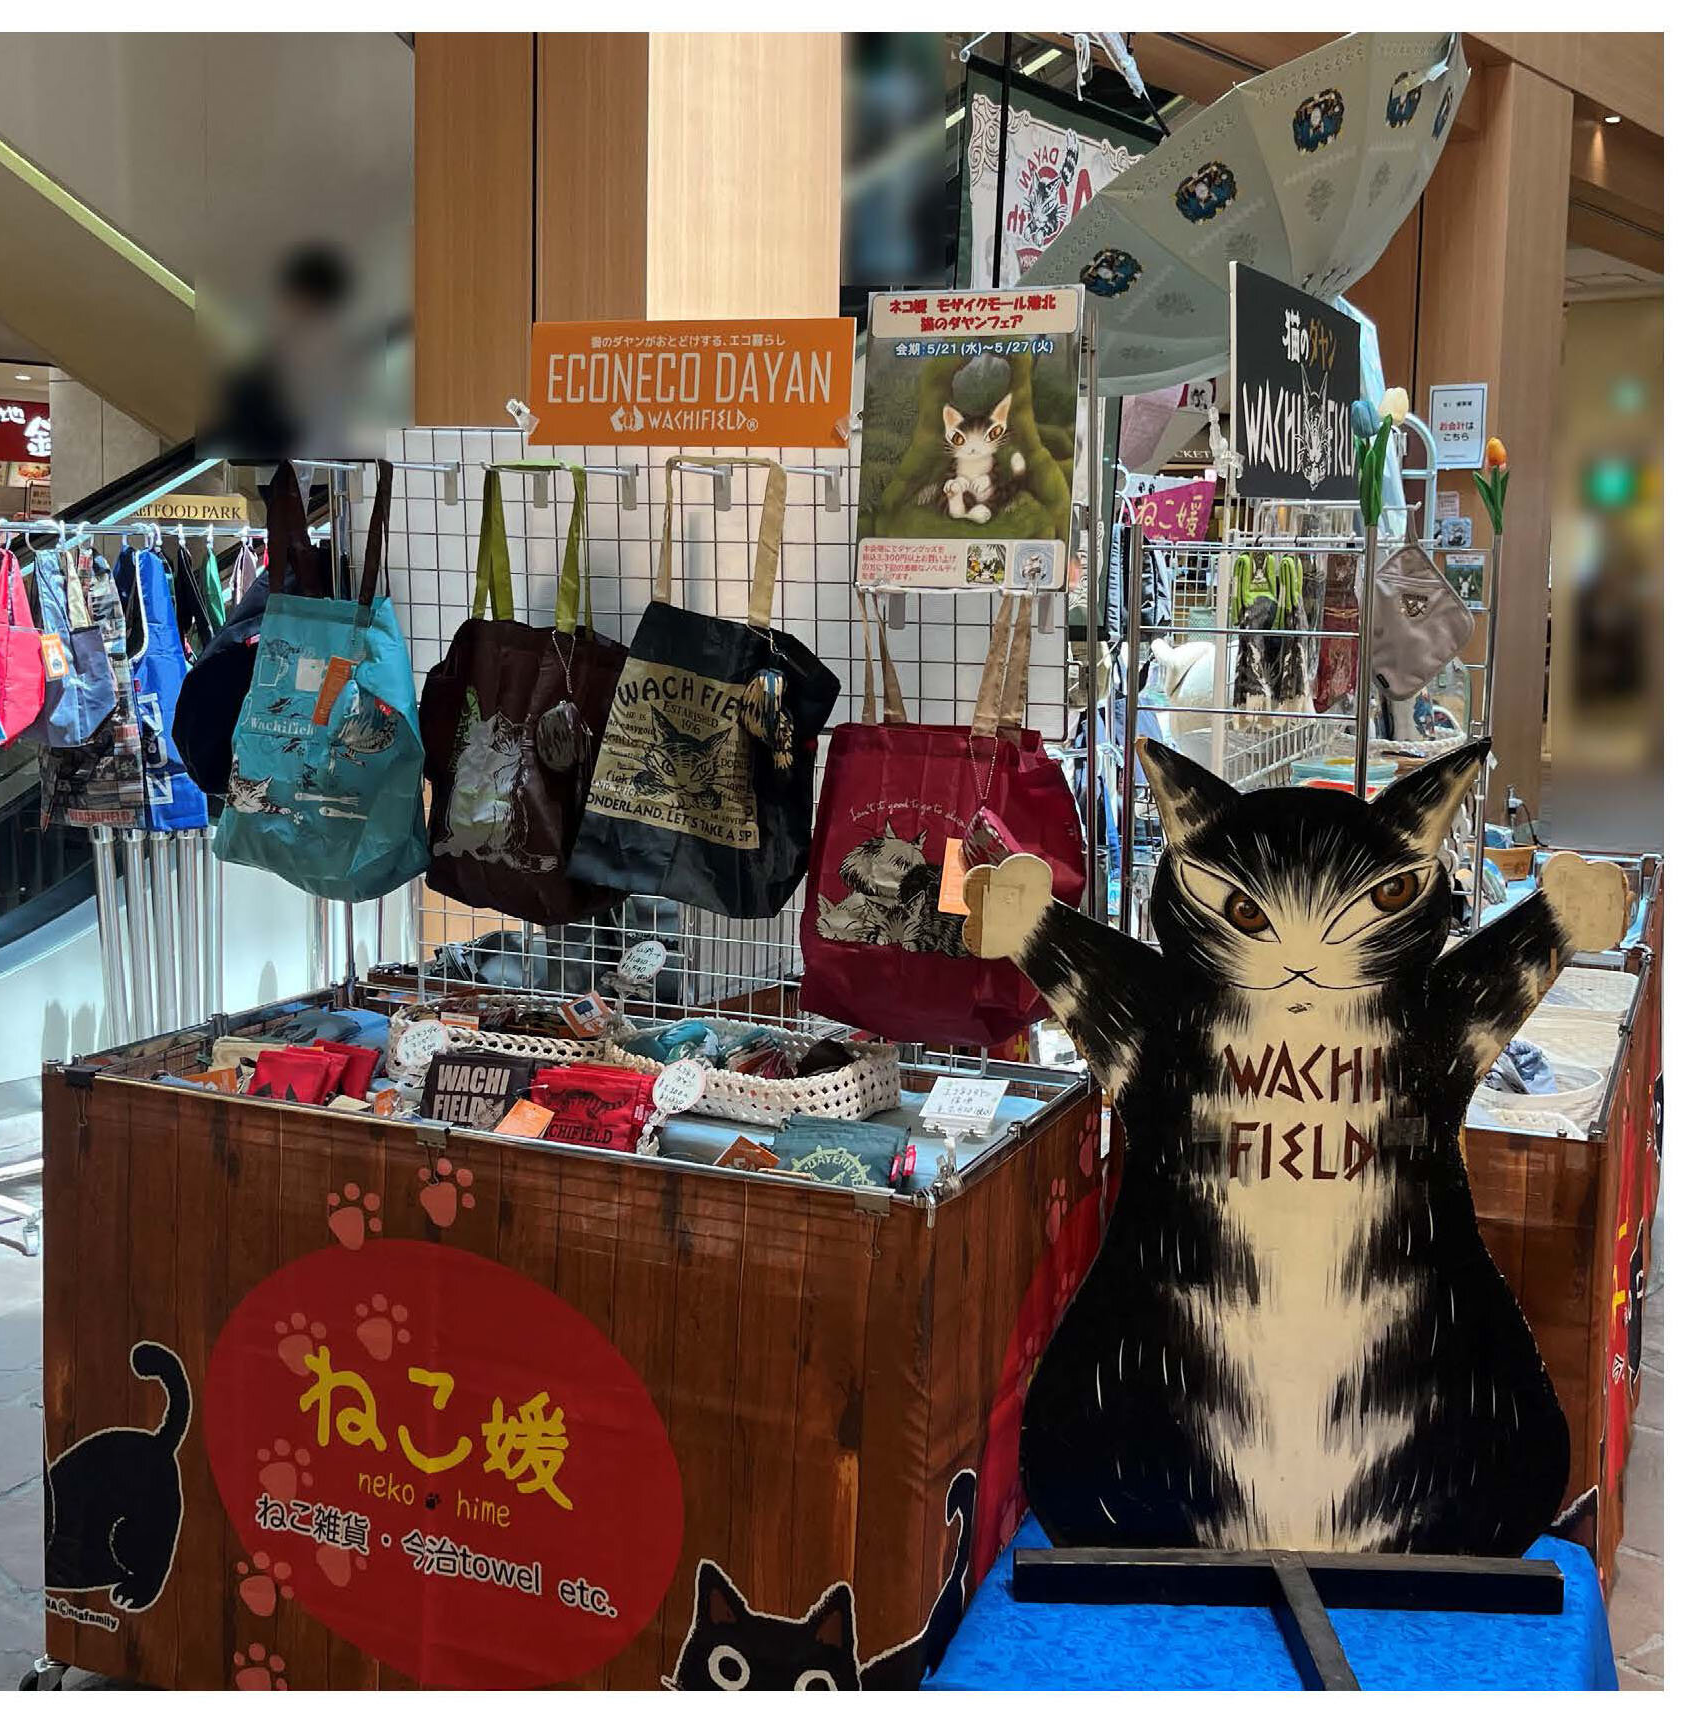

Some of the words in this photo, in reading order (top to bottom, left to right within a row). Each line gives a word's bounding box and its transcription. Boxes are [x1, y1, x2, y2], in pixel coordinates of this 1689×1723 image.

[547, 351, 701, 404] ECONECO
[715, 351, 832, 404] DAYAN
[154, 504, 198, 518] FOOD
[202, 505, 242, 519] PARK
[436, 1063, 511, 1096] WACHI
[1223, 1039, 1383, 1104] WACHI
[547, 1122, 614, 1145] CHIFIELD
[1229, 1120, 1377, 1182] FIELD
[298, 1345, 575, 1511] ねこ媛
[358, 1472, 415, 1505] neko
[456, 1490, 511, 1528] hime
[558, 1578, 618, 1618] etc.
